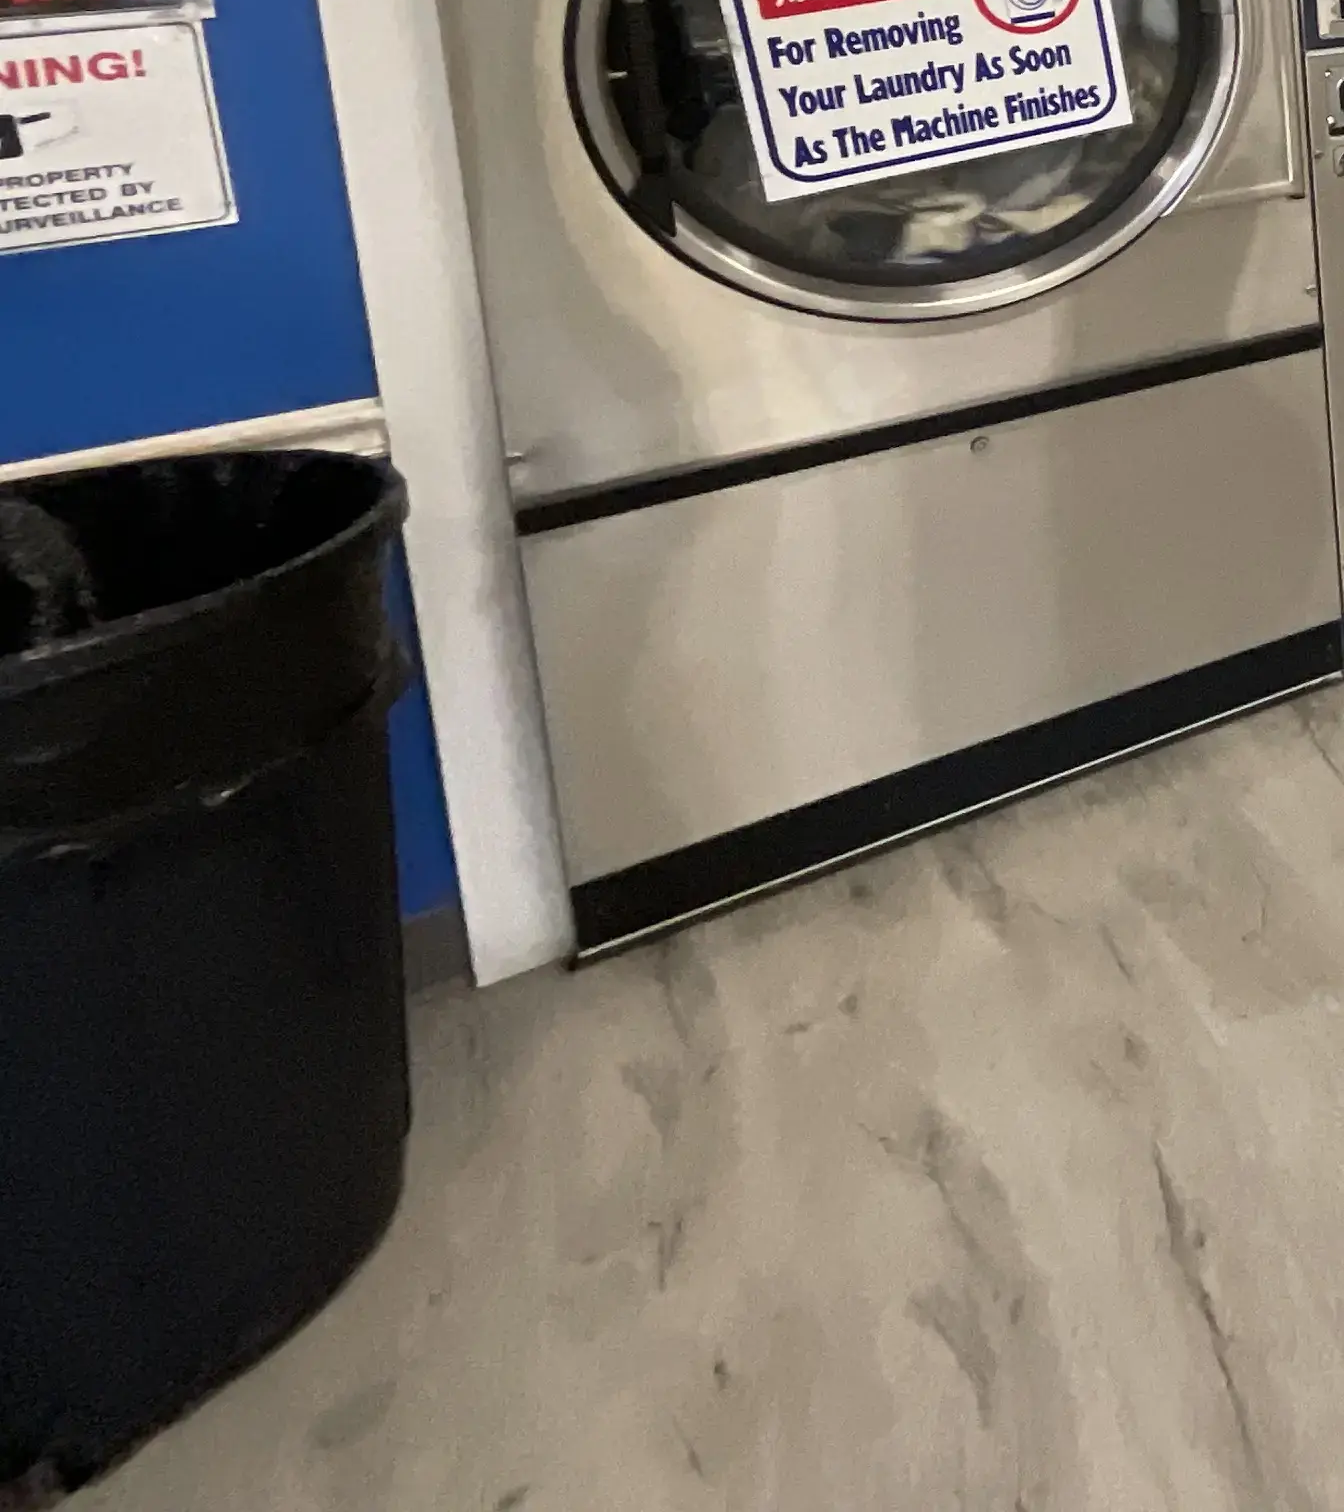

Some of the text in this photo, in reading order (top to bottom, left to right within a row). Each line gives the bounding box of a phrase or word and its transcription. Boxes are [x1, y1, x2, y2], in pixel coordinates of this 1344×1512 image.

[768, 12, 963, 68] For Removing
[779, 44, 1072, 117] Your Laundry As Soon
[794, 84, 1100, 168] As The Machine Finishes
[121, 180, 155, 196] BY
